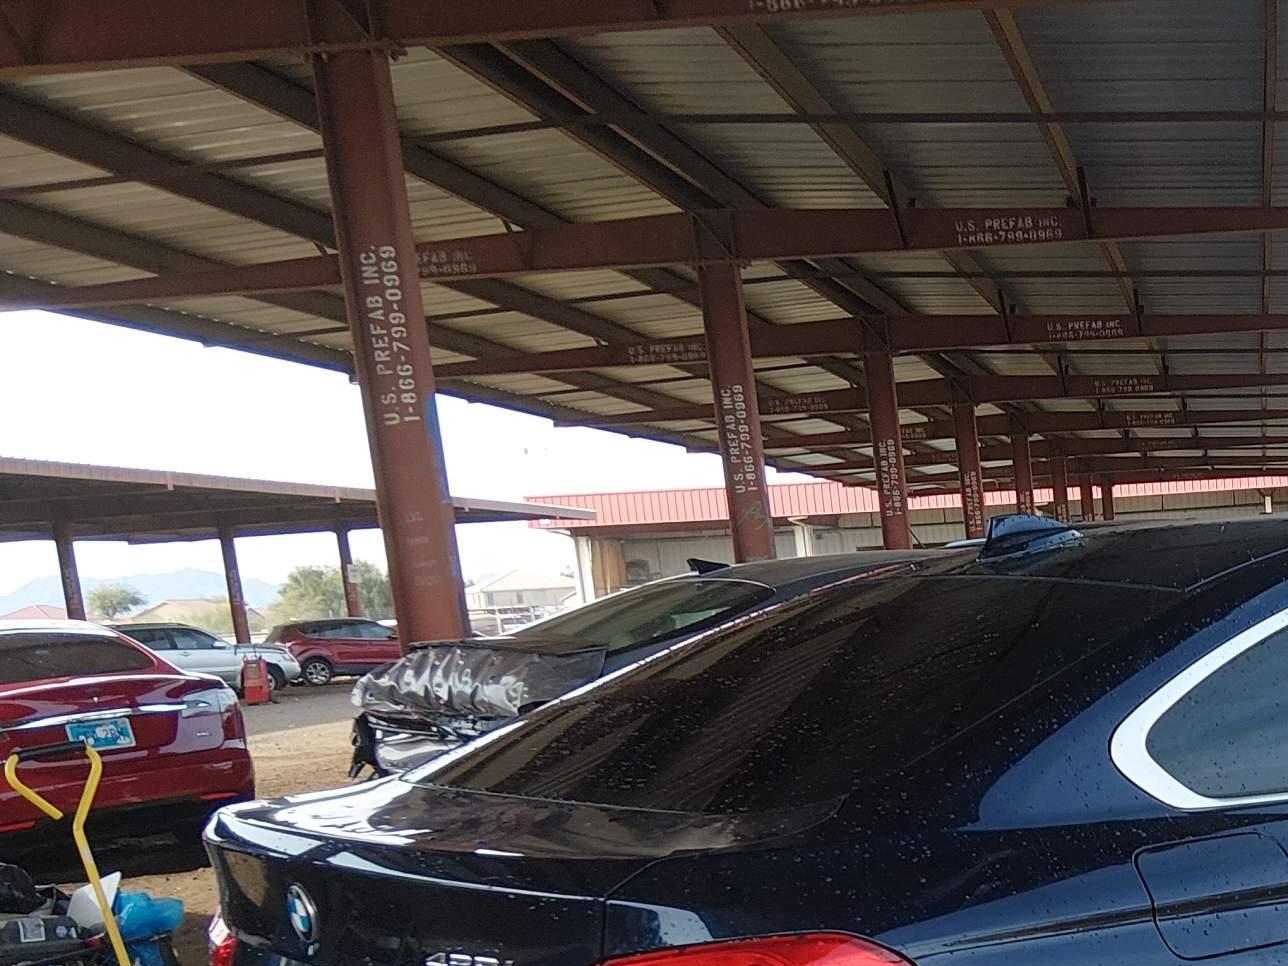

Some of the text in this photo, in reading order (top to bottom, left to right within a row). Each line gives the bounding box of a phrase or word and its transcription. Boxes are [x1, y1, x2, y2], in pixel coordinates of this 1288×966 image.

[955, 219, 979, 233] U.S.
[985, 216, 1033, 230] PREFAB
[360, 245, 400, 426] U.S. PREFAB INC.
[379, 245, 421, 423] 1-866-799-0969
[724, 415, 742, 463] PREFAB
[734, 469, 746, 494] U.S.
